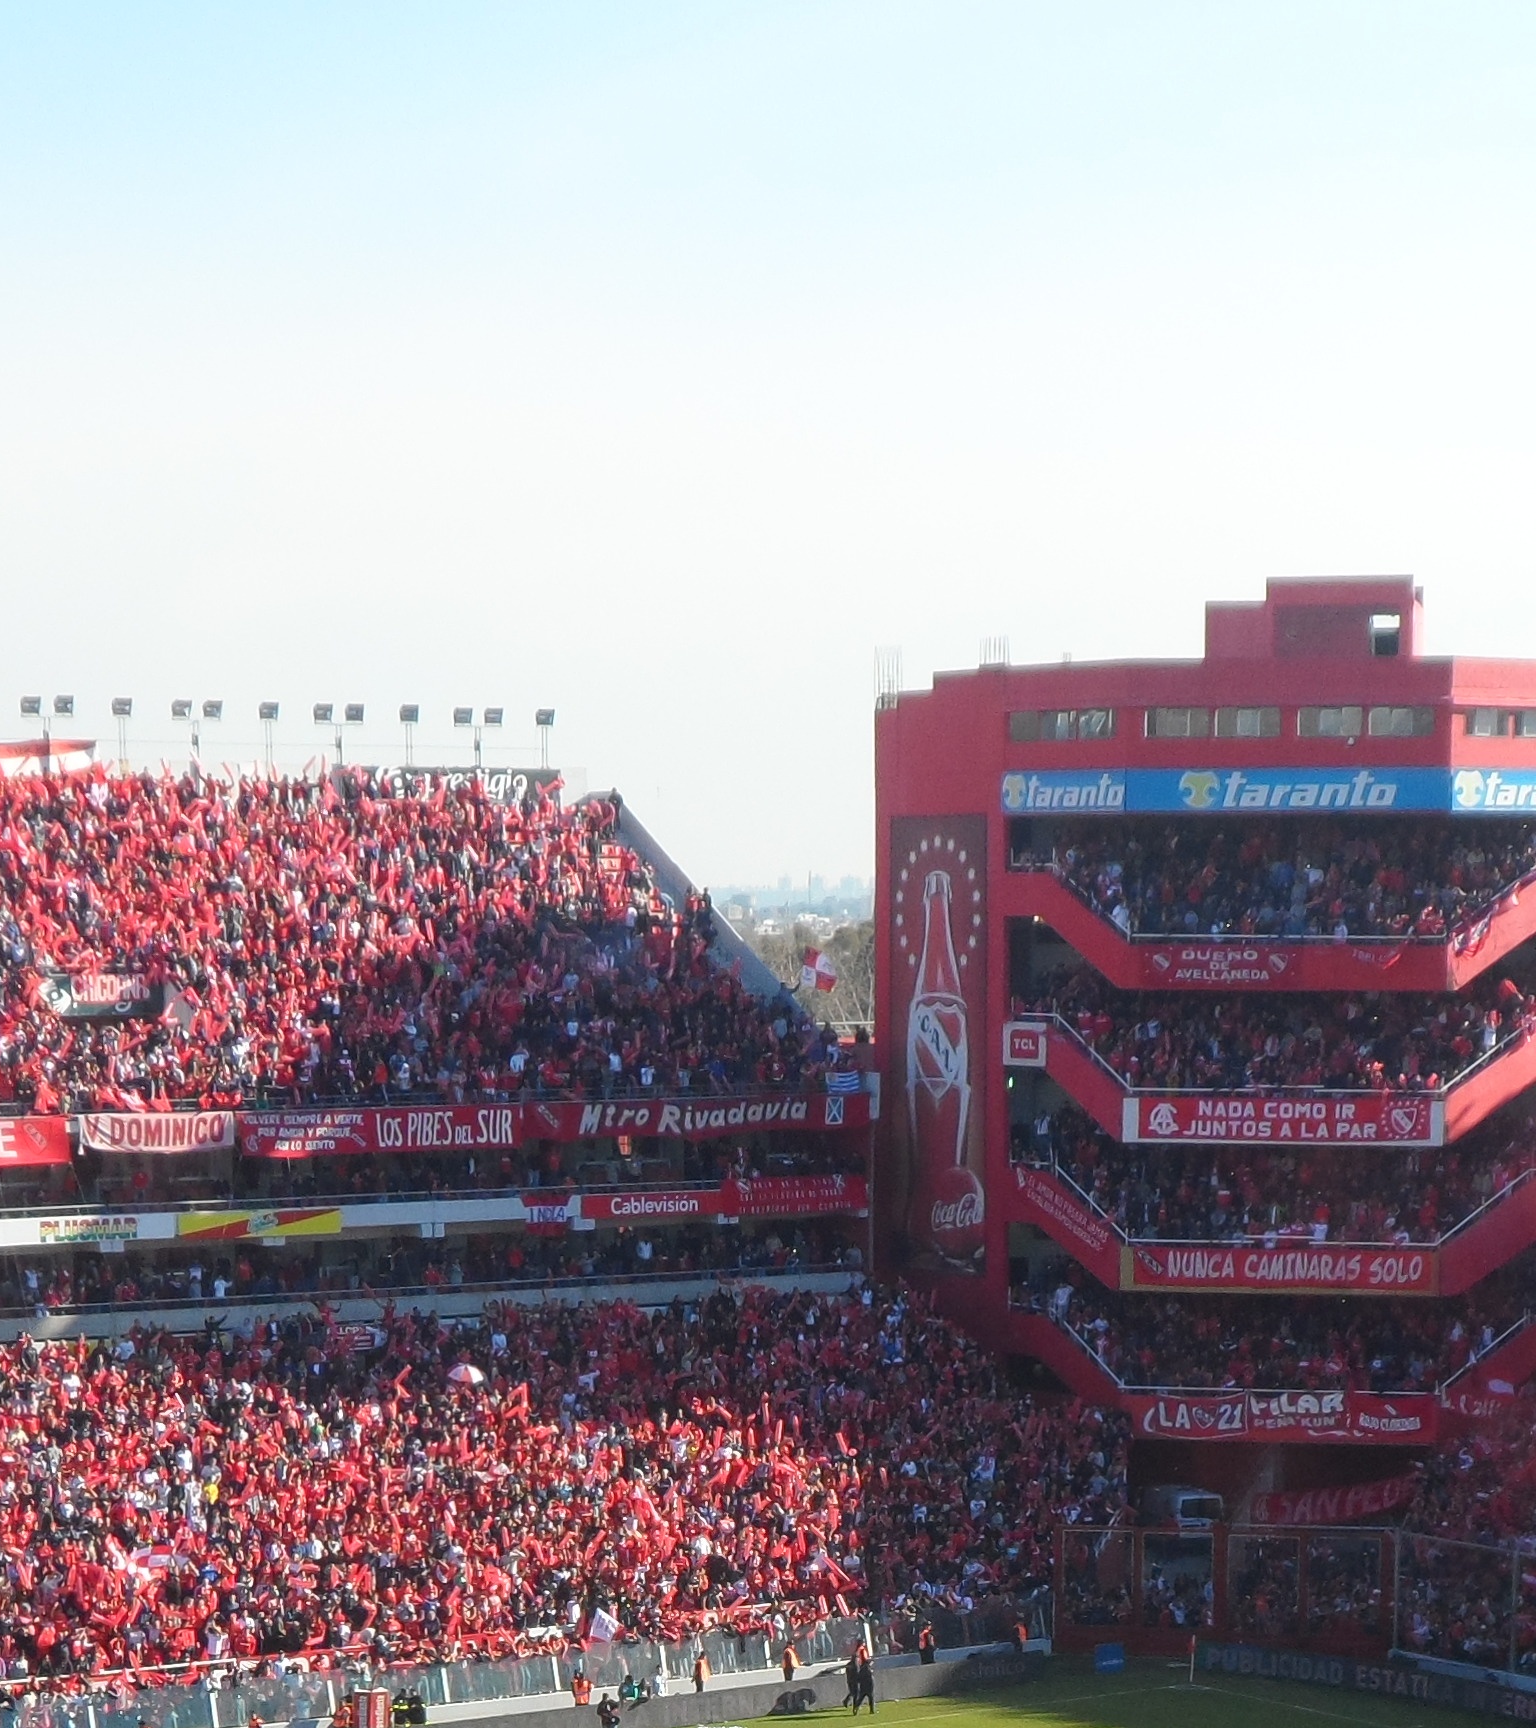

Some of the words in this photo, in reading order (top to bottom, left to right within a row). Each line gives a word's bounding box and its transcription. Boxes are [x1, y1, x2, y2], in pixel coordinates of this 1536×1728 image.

[1026, 773, 1125, 808] taranto
[1221, 771, 1398, 808] taranto
[1175, 969, 1270, 981] AVELLANEDA
[1209, 962, 1230, 971] DE
[1013, 1038, 1036, 1051] TCL
[657, 1096, 808, 1135] Rivadavia
[1198, 1101, 1256, 1119] NADA
[1263, 1101, 1326, 1119] COMO
[1334, 1103, 1356, 1120] IR
[107, 1112, 225, 1147] DOMINICO
[376, 1113, 403, 1148] LOS
[407, 1111, 454, 1147] PIBES
[454, 1124, 475, 1146] DEL
[476, 1109, 514, 1145] SUR
[1182, 1120, 1272, 1137] JUNTOS
[1279, 1121, 1293, 1137] A
[1300, 1121, 1329, 1138] LA
[1335, 1123, 1377, 1139] PAR
[610, 1194, 700, 1216] Cablevisión
[38, 1216, 139, 1243] PLUSMAR
[1167, 1249, 1235, 1279] NUNCA
[1244, 1251, 1362, 1282] CAMINARAS
[1368, 1255, 1424, 1284] SOLO
[1217, 1403, 1244, 1431] 21
